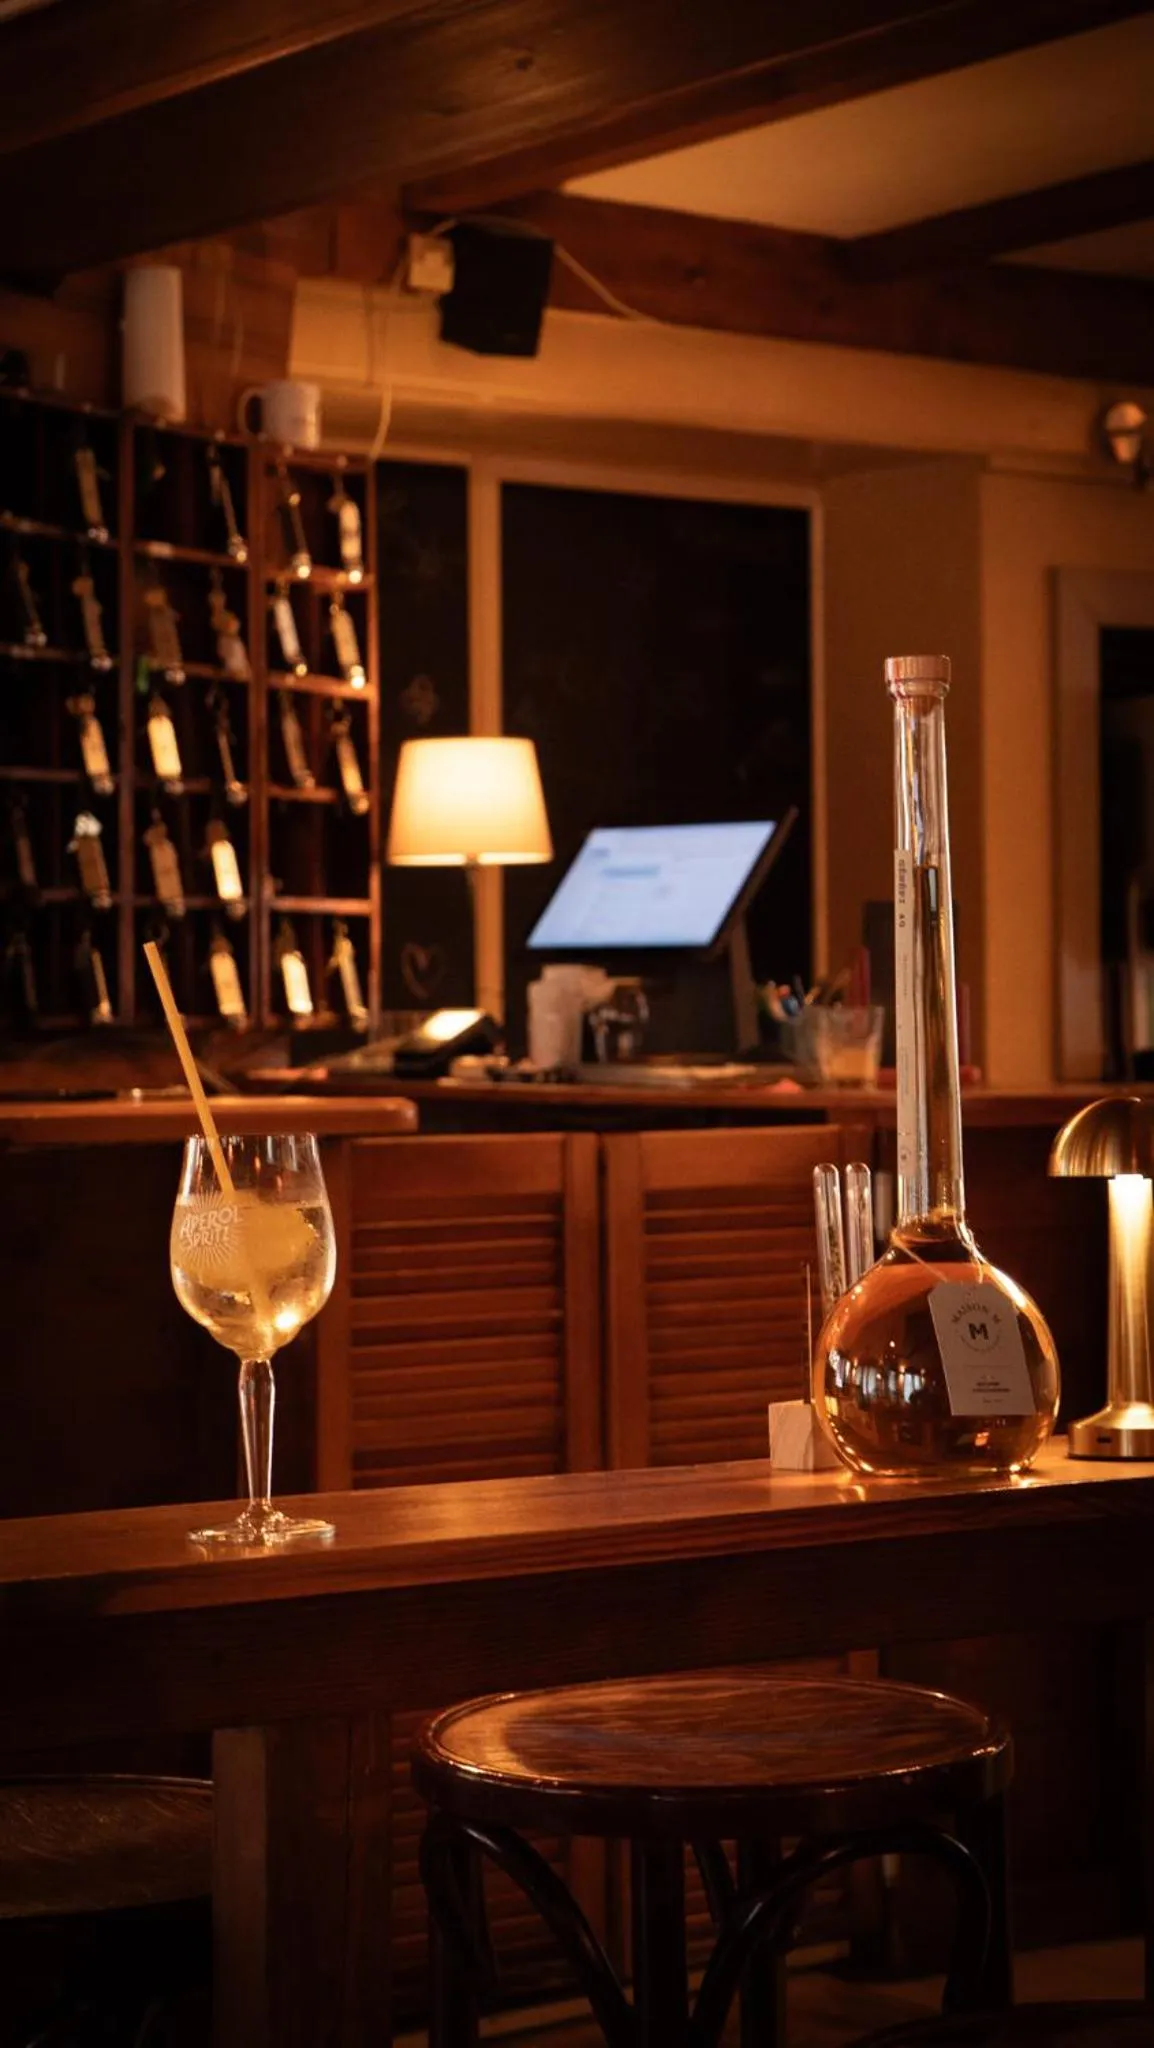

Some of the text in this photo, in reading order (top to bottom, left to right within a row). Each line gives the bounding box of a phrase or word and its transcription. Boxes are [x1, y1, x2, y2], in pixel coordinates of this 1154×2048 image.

[180, 1205, 243, 1239] APEROL
[186, 1227, 230, 1248] SPRITZ
[968, 1322, 990, 1340] M
